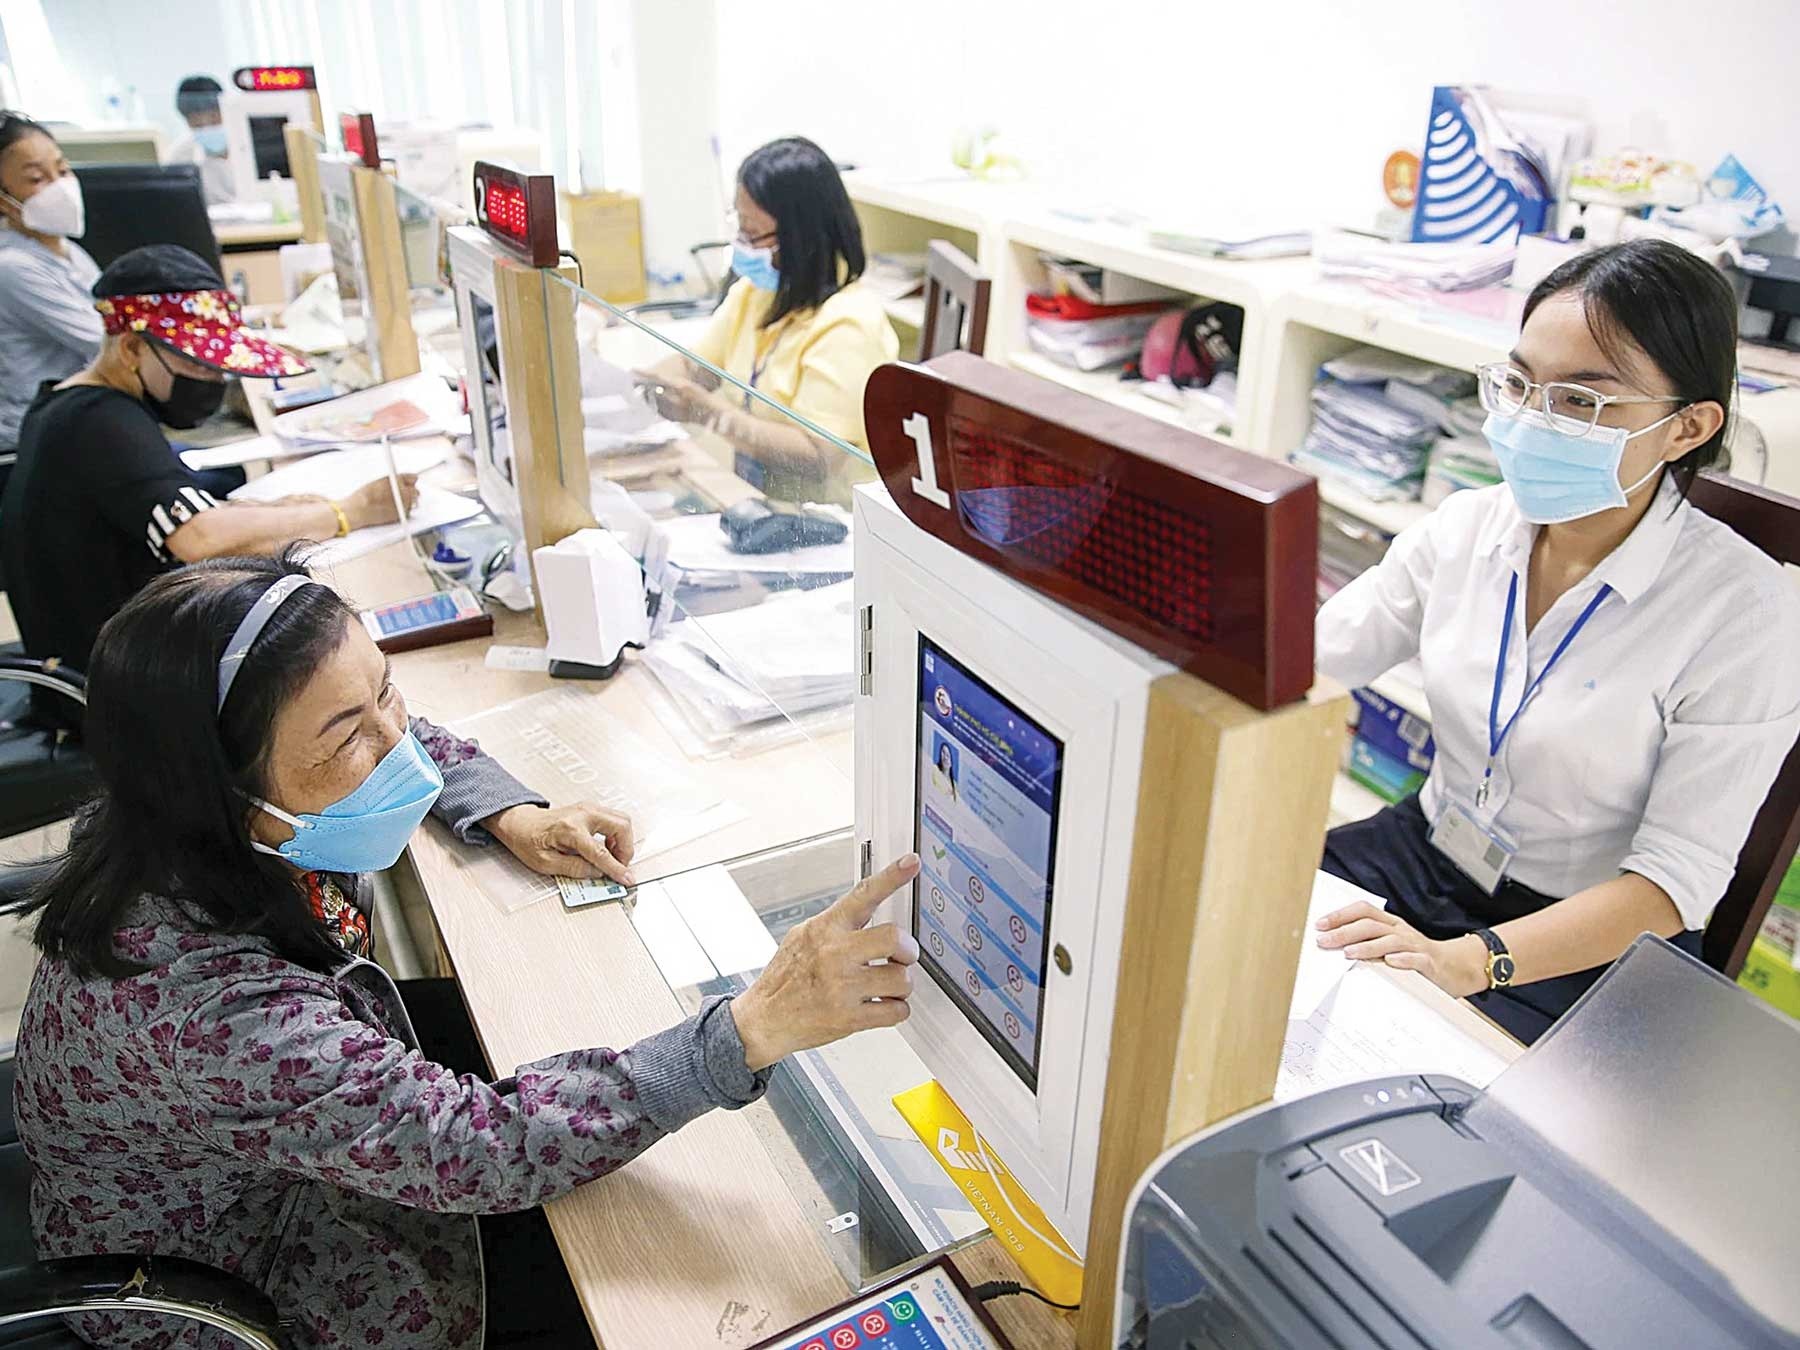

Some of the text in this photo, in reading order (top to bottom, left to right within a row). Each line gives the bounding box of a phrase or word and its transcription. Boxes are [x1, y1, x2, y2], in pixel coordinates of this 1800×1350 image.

[475, 177, 488, 222] 2
[902, 411, 951, 510] 1
[965, 1179, 1004, 1227] VIETNAM
